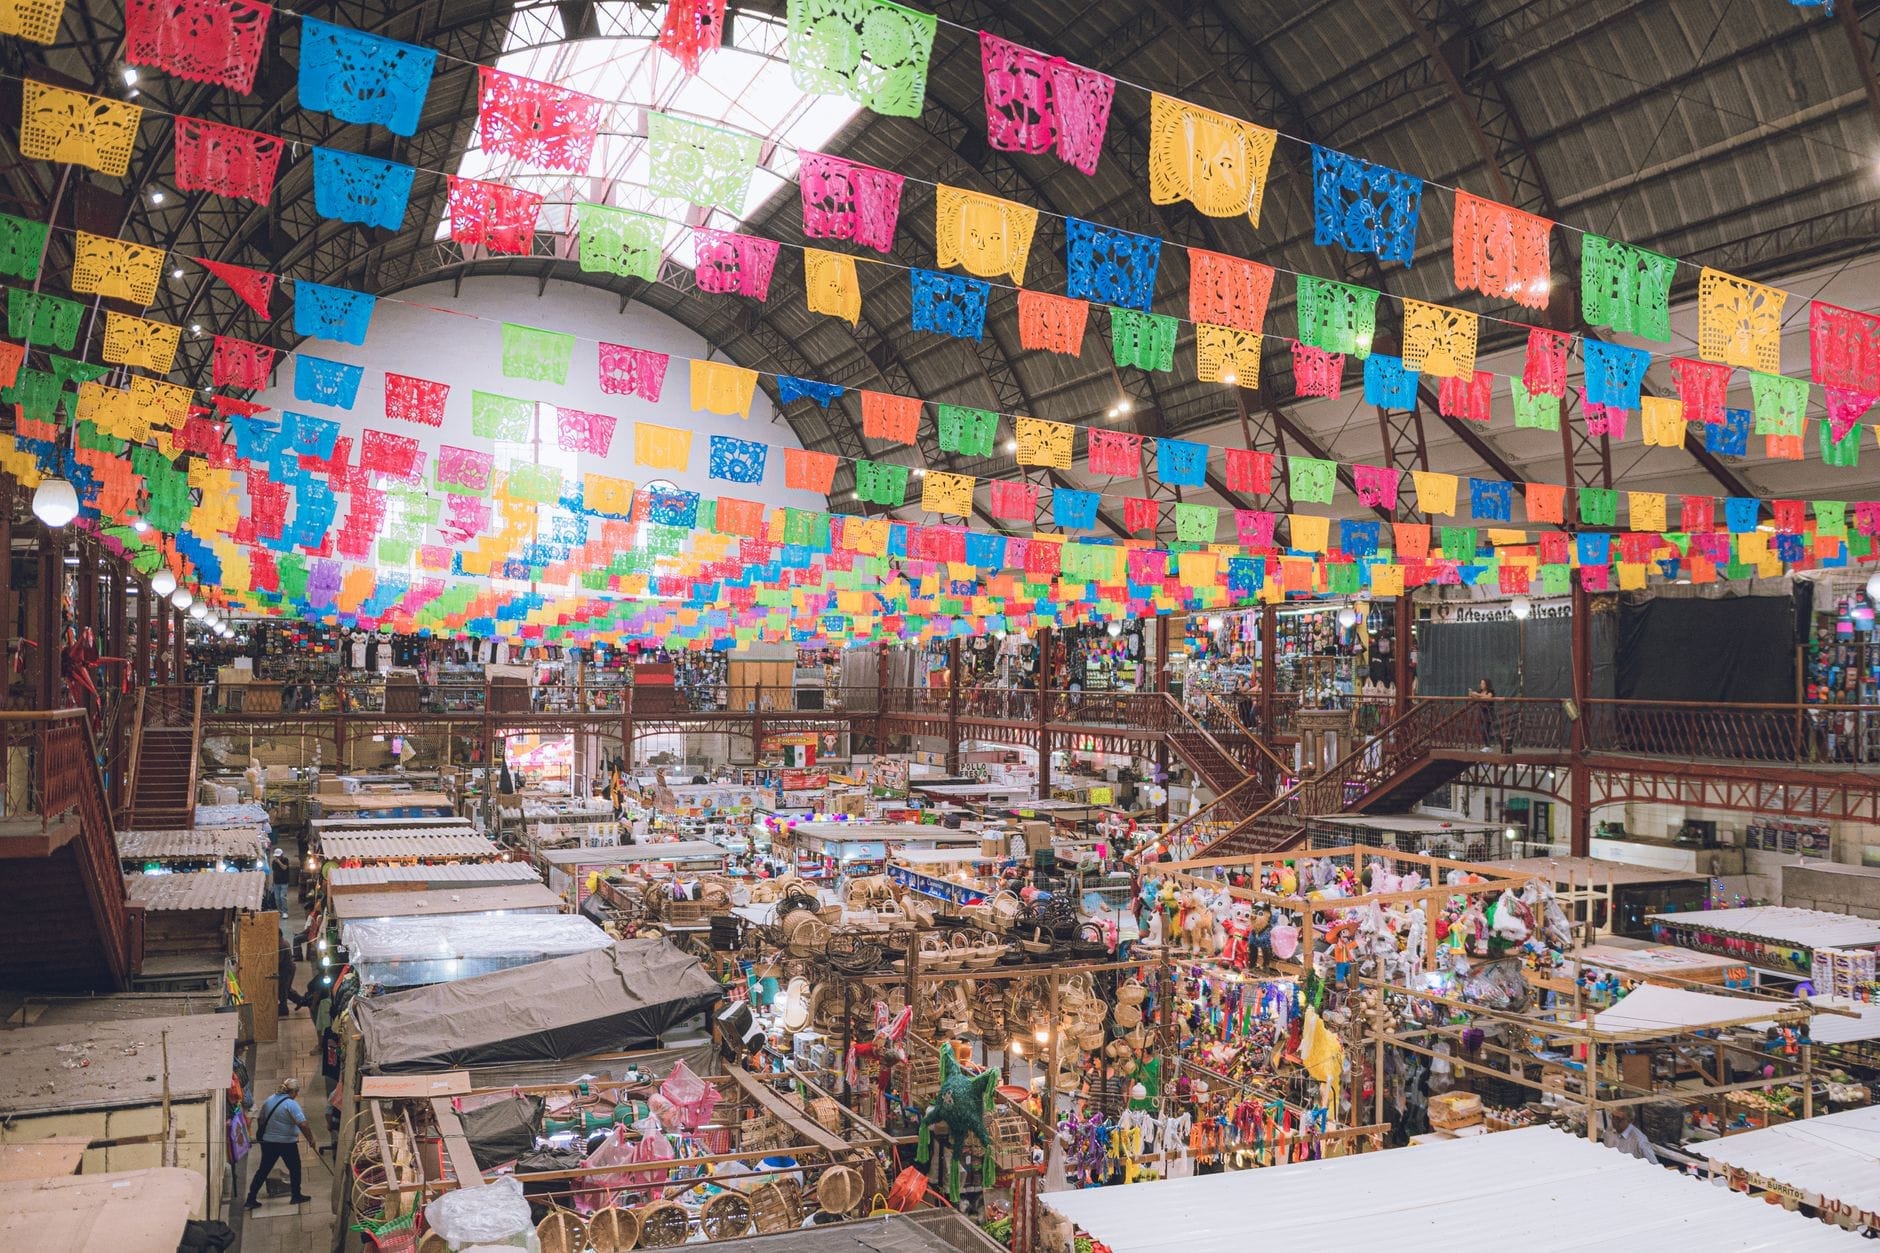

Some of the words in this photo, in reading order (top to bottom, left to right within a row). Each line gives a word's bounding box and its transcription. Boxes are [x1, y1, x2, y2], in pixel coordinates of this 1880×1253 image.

[960, 763, 987, 771] POLLO
[960, 770, 988, 778] FRESO
[1767, 1181, 1805, 1200] BURRITOS
